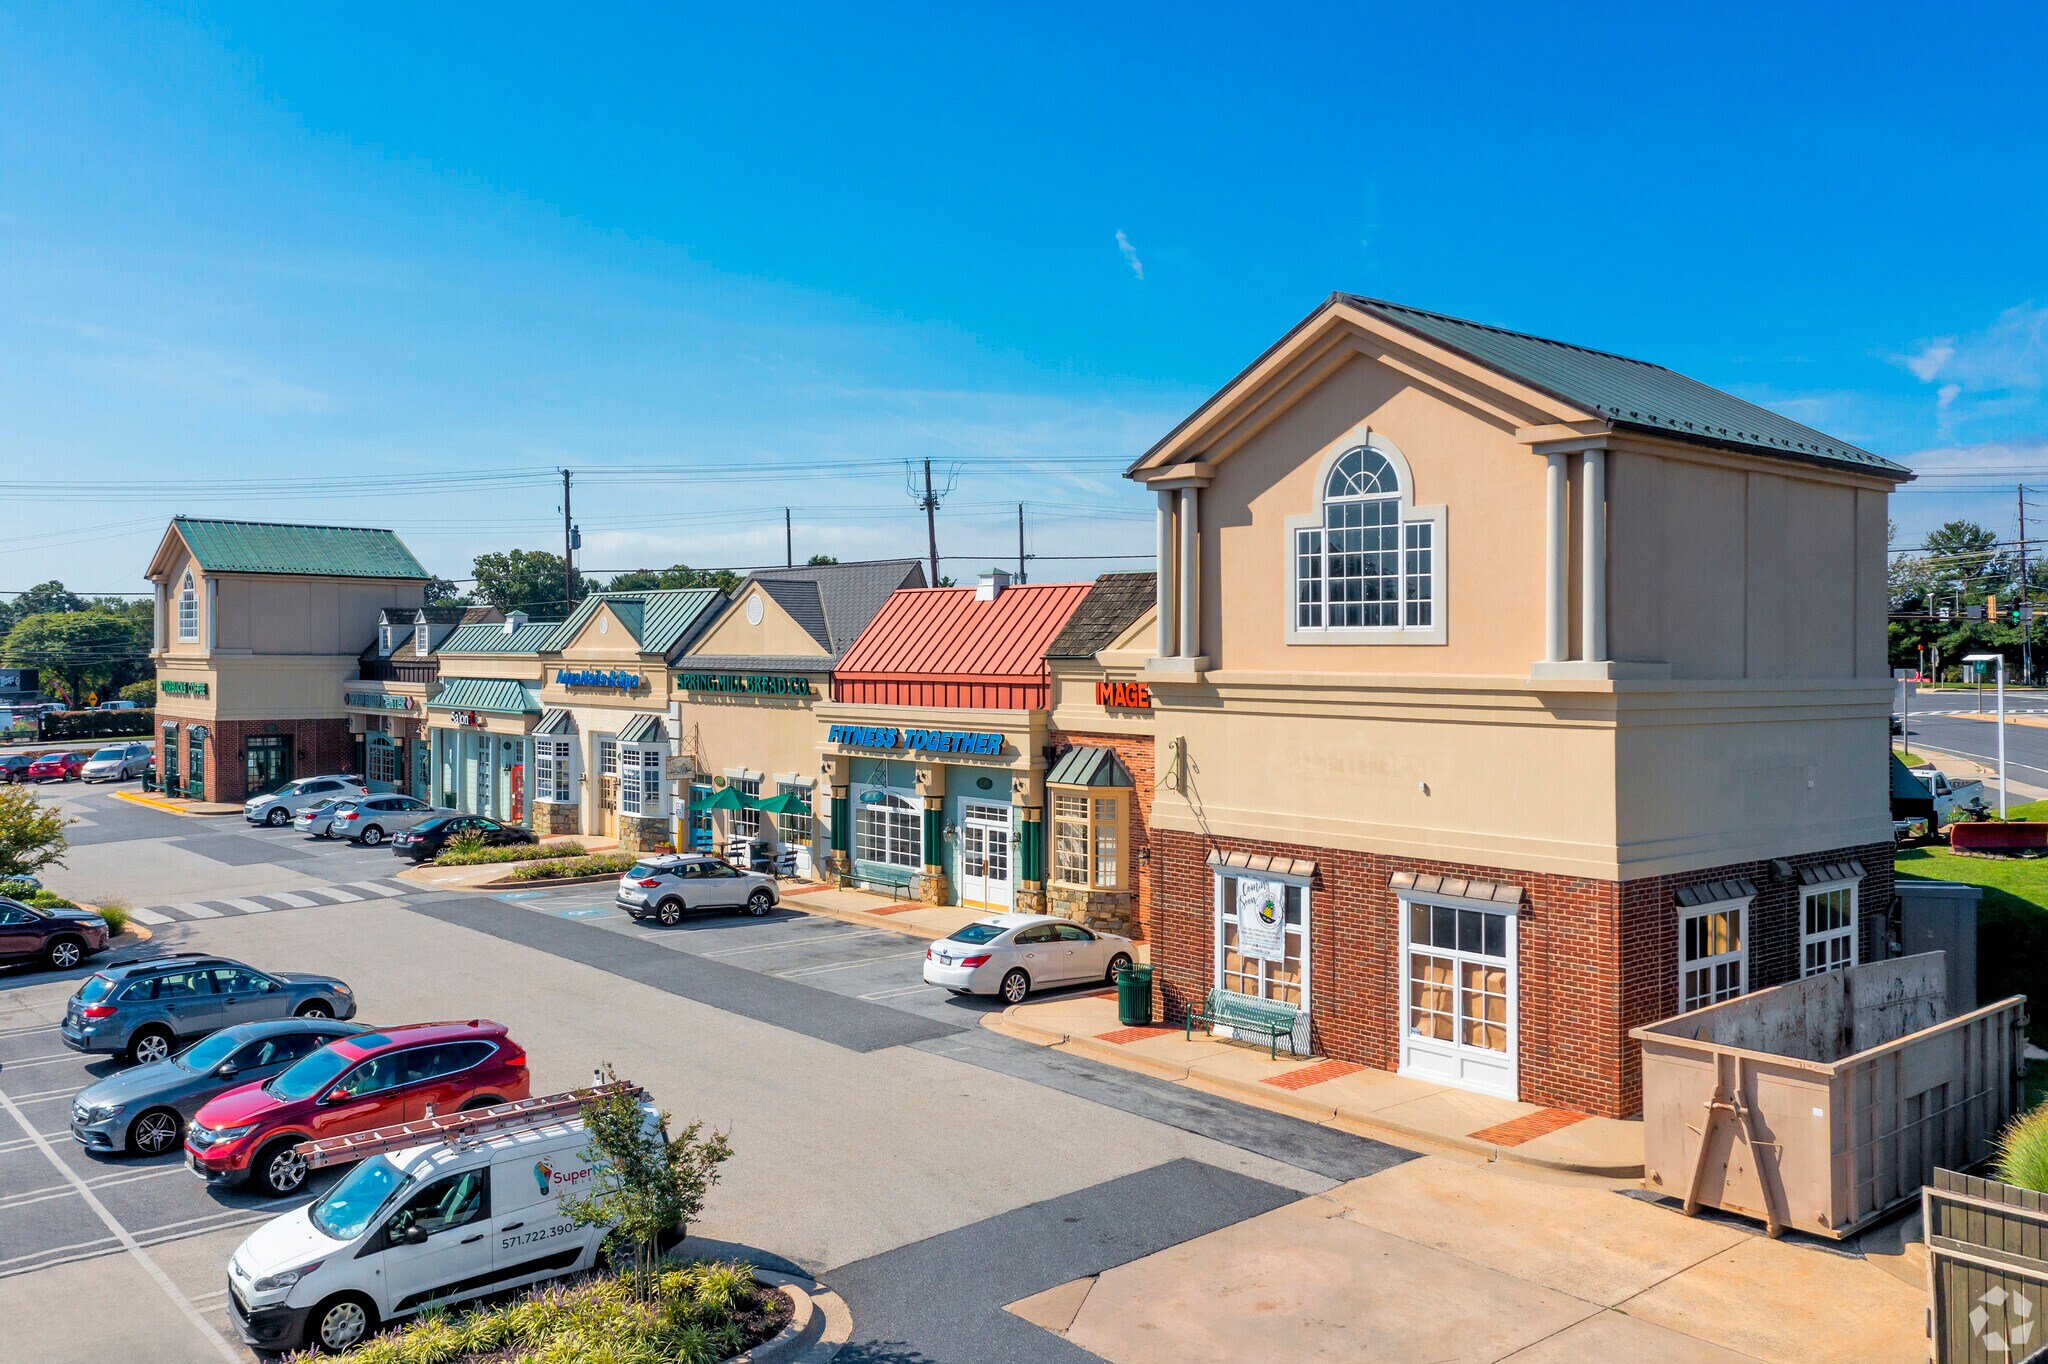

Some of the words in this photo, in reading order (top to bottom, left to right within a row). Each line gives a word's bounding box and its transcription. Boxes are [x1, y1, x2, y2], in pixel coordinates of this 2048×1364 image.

[608, 670, 617, 687] &
[618, 670, 639, 692] Spa
[677, 674, 715, 691] SPRING
[716, 675, 746, 693] MILL
[746, 676, 788, 695] BREAD
[789, 677, 811, 696] CO.
[1095, 681, 1150, 708] IMAGE
[450, 711, 469, 725] Salon
[828, 724, 899, 748] FITNESS
[903, 728, 1003, 755] TOGETHER
[502, 1222, 580, 1249] 571.722.3909
